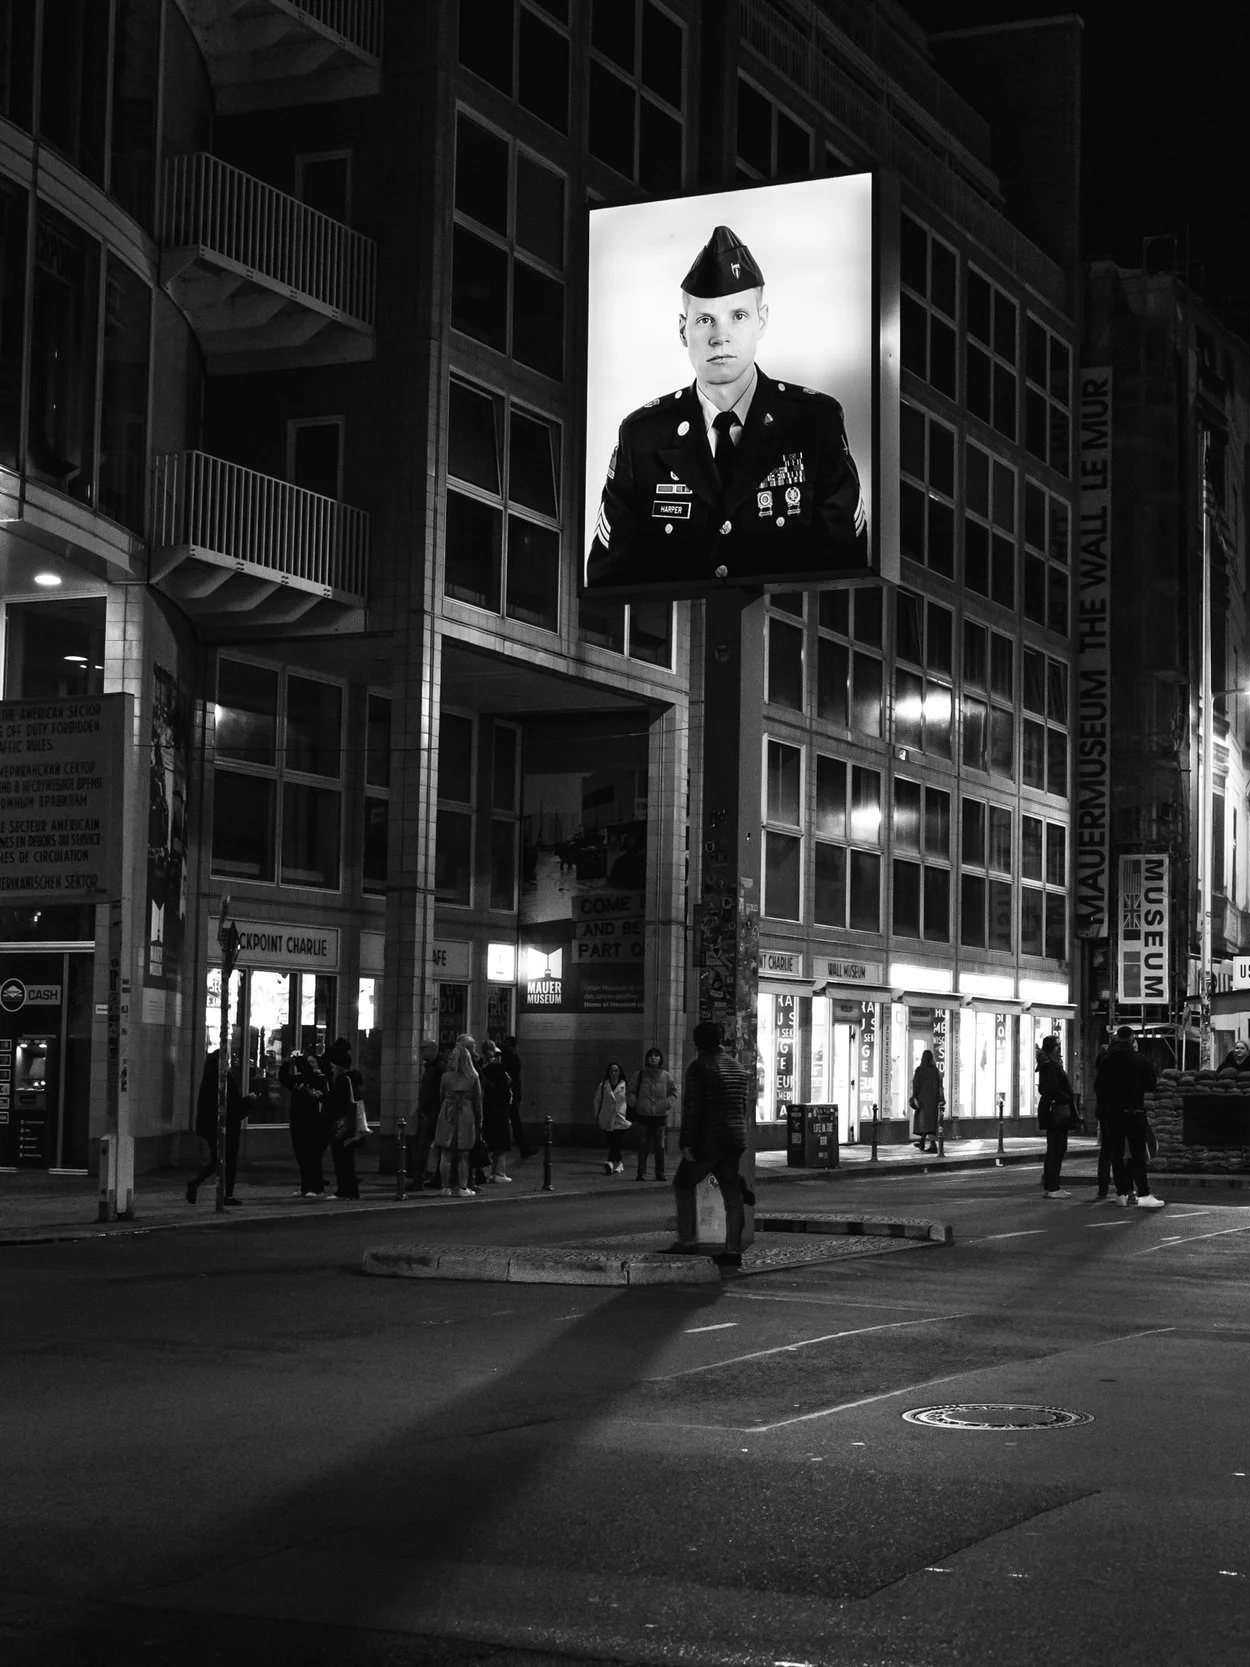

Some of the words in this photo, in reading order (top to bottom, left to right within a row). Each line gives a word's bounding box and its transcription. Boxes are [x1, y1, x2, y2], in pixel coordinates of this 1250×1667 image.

[1081, 378, 1108, 450] MUR
[1080, 460, 1107, 491] LE
[660, 505, 682, 514] HARPER
[1079, 506, 1107, 592] WALL
[1079, 599, 1106, 654] THE
[20, 706, 64, 720] AMERICAN
[68, 703, 102, 718] SECTOR
[7, 724, 22, 737] OFF
[27, 722, 48, 737] DUTY
[51, 719, 100, 734] FORBIDDEN
[27, 738, 53, 752] RULES
[64, 761, 96, 775] СЕКТОР
[39, 794, 88, 808] ПРАВИЛАМ
[1079, 669, 1107, 924] MAUERMUSEUM
[10, 819, 47, 833] SECTEUR
[16, 835, 26, 848] EN
[28, 833, 56, 847] DEHORS
[71, 832, 101, 846] SERVICE
[19, 850, 29, 863] DE
[33, 849, 89, 863] CIRCULATION
[65, 874, 99, 889] SEKTOR
[581, 896, 631, 915] COME
[583, 922, 615, 937] AND
[622, 921, 641, 936] BE
[1144, 859, 1164, 998] MUSEUM
[286, 936, 327, 957] CHARLIE
[579, 942, 622, 958] PART
[768, 955, 793, 972] CHARLIE
[827, 962, 843, 977] WALL
[843, 963, 866, 979] MUSEUM
[29, 989, 58, 1001] CASH
[527, 981, 562, 994] MAUER
[527, 994, 562, 1005] MUSEUM
